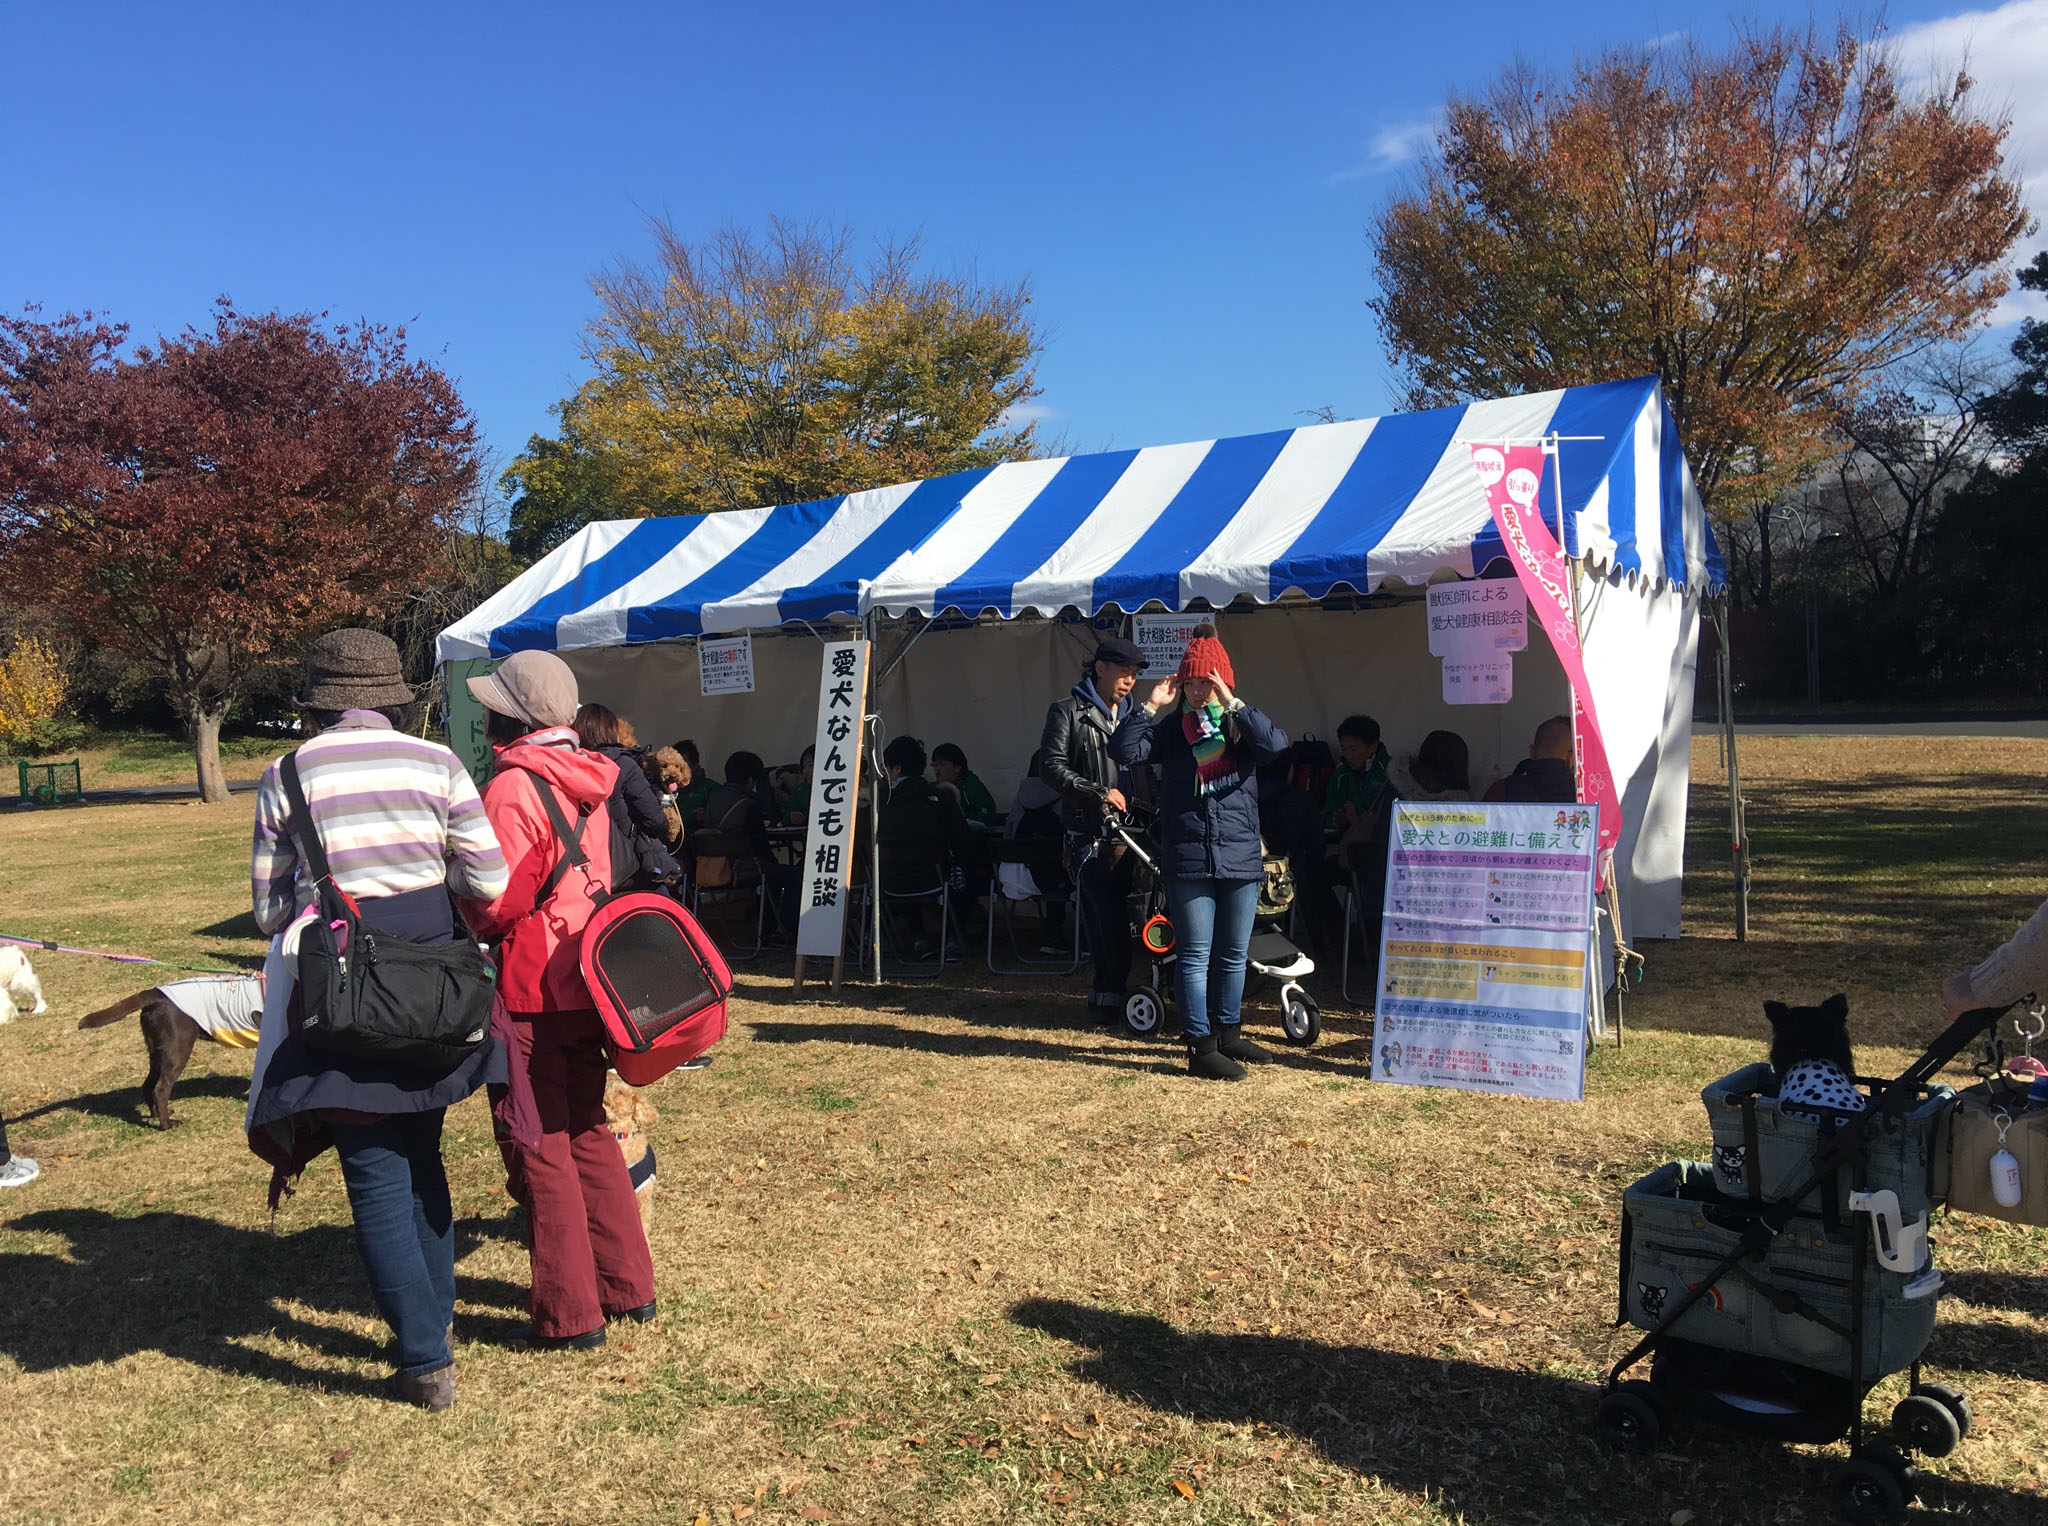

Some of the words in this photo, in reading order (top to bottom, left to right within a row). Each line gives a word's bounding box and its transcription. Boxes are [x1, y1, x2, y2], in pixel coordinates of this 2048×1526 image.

[1508, 478, 1534, 493] 引っ張り
[1430, 586, 1508, 607] 獣医師による
[1431, 610, 1524, 632] 愛犬健康相談会
[812, 648, 856, 907] 愛犬なんでも相談
[1402, 829, 1584, 849] 愛犬との避難に備えて
